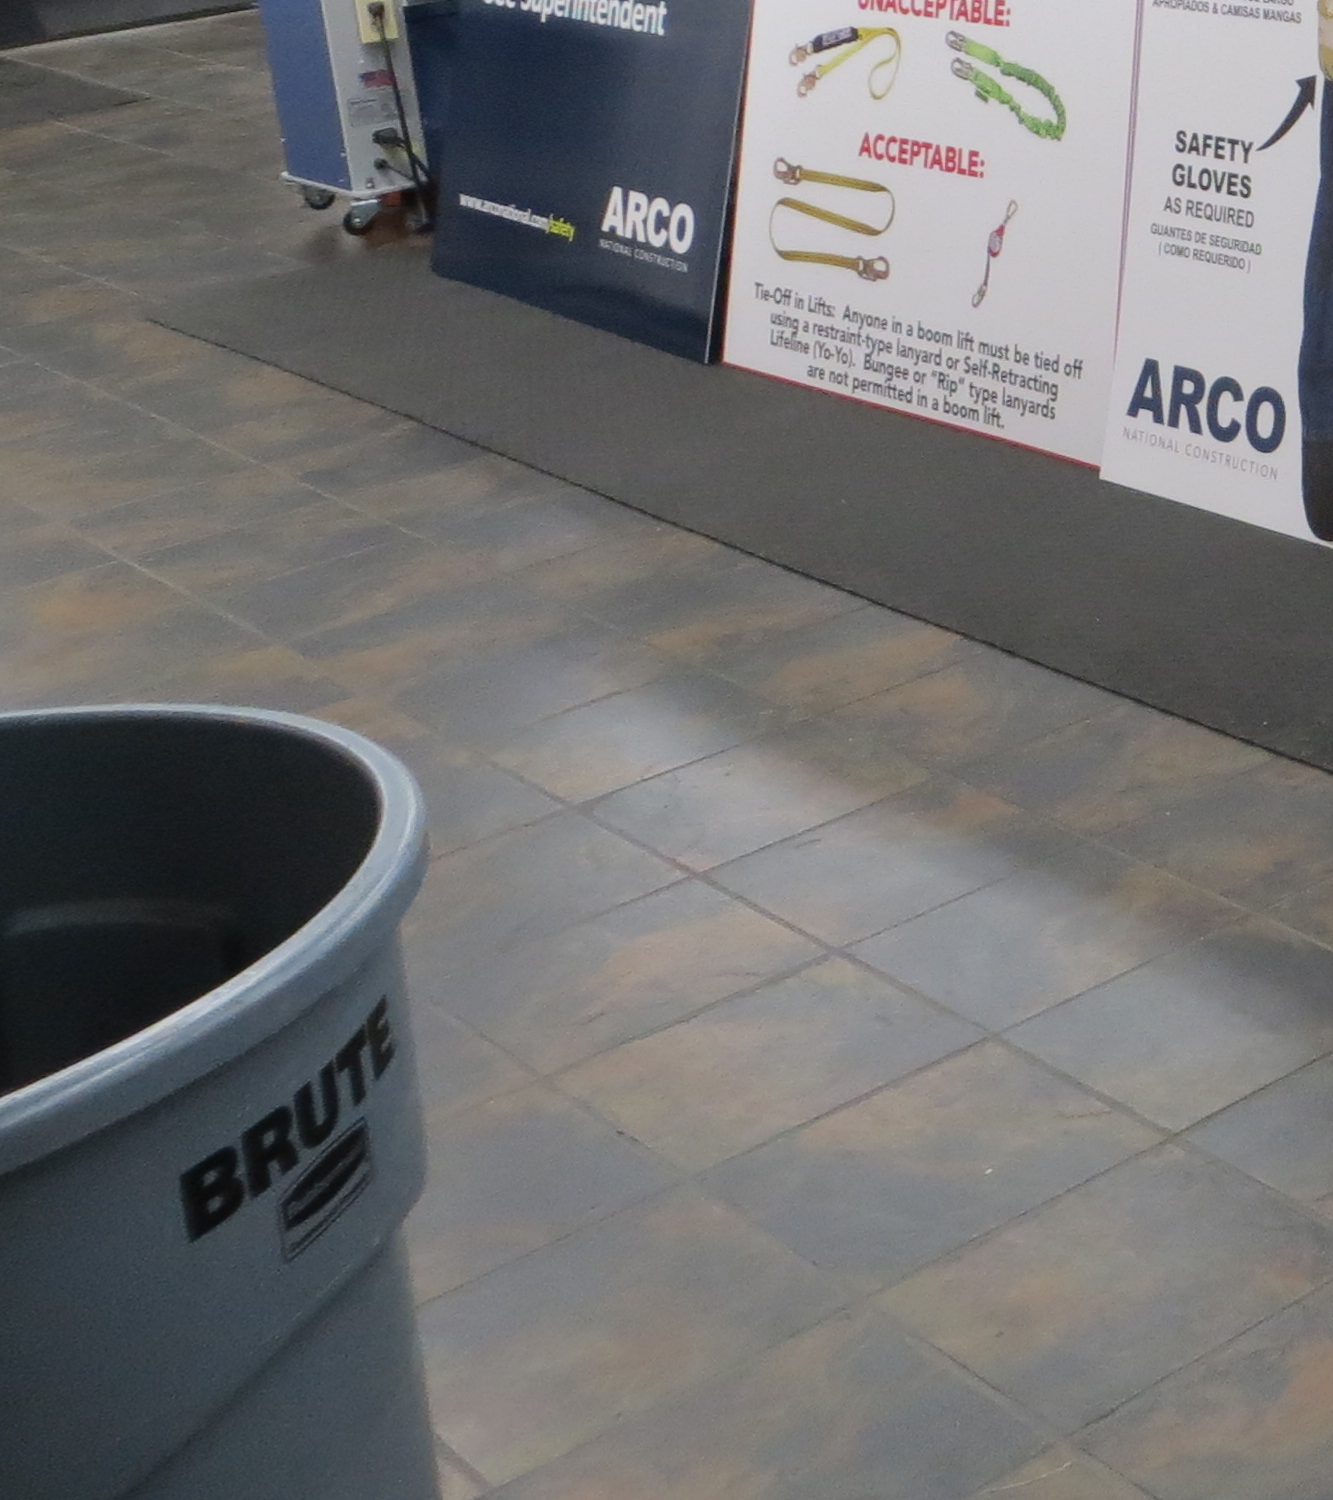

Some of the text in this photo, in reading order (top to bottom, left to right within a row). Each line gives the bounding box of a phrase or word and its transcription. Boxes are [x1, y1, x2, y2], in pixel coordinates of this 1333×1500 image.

[858, 132, 986, 179] ACCEPTABLE:
[1174, 129, 1255, 166] SAFETY
[1171, 163, 1253, 199] GLOVES
[602, 185, 695, 254] ARCO
[1163, 194, 1255, 229] AS REQUIRED
[1150, 222, 1263, 257] GUANTES DE SEGURIDAD
[754, 282, 793, 307] Tie-Off
[794, 293, 804, 310] in
[842, 305, 888, 330] Anyone
[892, 316, 902, 333] in
[906, 324, 913, 337] a
[917, 321, 953, 347] boom
[957, 330, 975, 352] lift
[978, 341, 1010, 361] must
[1014, 344, 1030, 365] be
[1034, 351, 1060, 373] tied
[1064, 358, 1084, 380] off
[770, 311, 1059, 402] using a restraint-type lanyard or Self-Retracting
[1126, 357, 1287, 455] ARCO
[1122, 426, 1279, 481] NATIONAL CONSTRUCTION
[178, 993, 397, 1244] BRUTE
